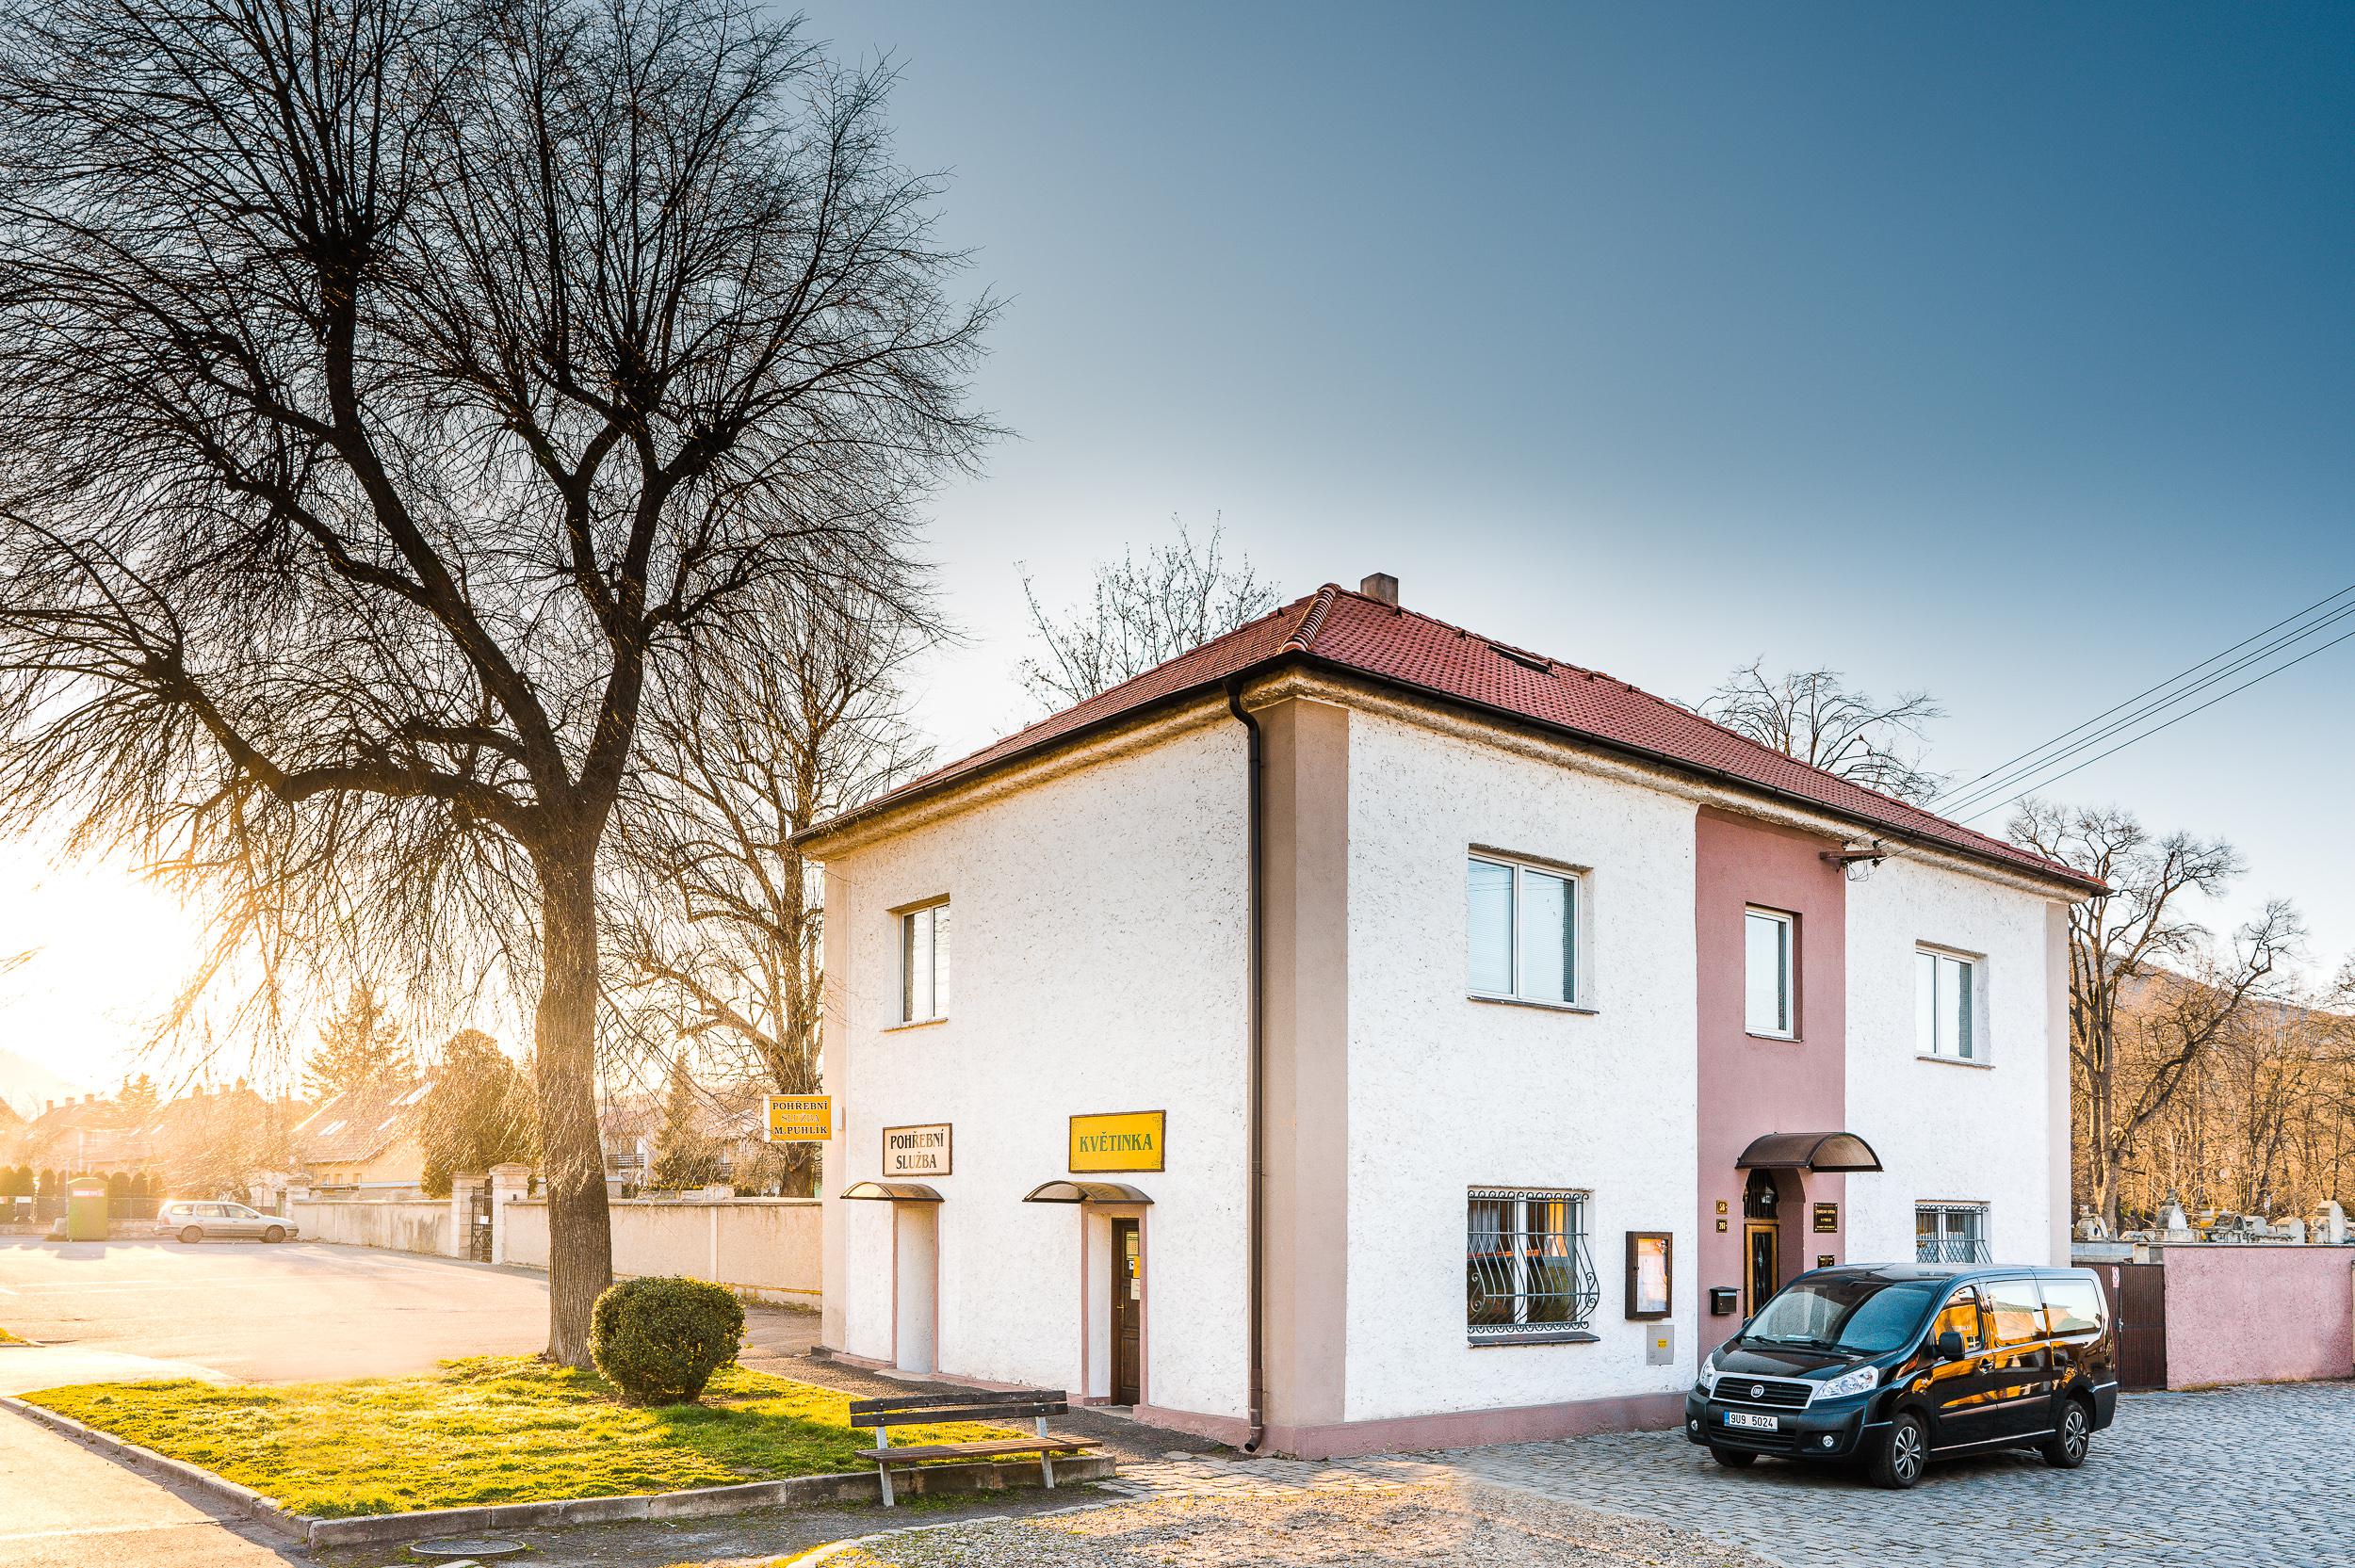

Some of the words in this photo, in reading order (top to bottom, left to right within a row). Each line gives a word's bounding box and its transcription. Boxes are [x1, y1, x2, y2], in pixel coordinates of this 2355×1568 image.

[772, 1100, 828, 1110] POHŘEBNÍ
[781, 1112, 820, 1123] SLUŽBA
[890, 1128, 944, 1150] POHŘEBNÍ
[1080, 1131, 1153, 1152] KVĚTINKA
[896, 1151, 937, 1170] SLUŽBA
[1730, 1414, 1746, 1425] 9U9
[1751, 1415, 1774, 1428] 5024
